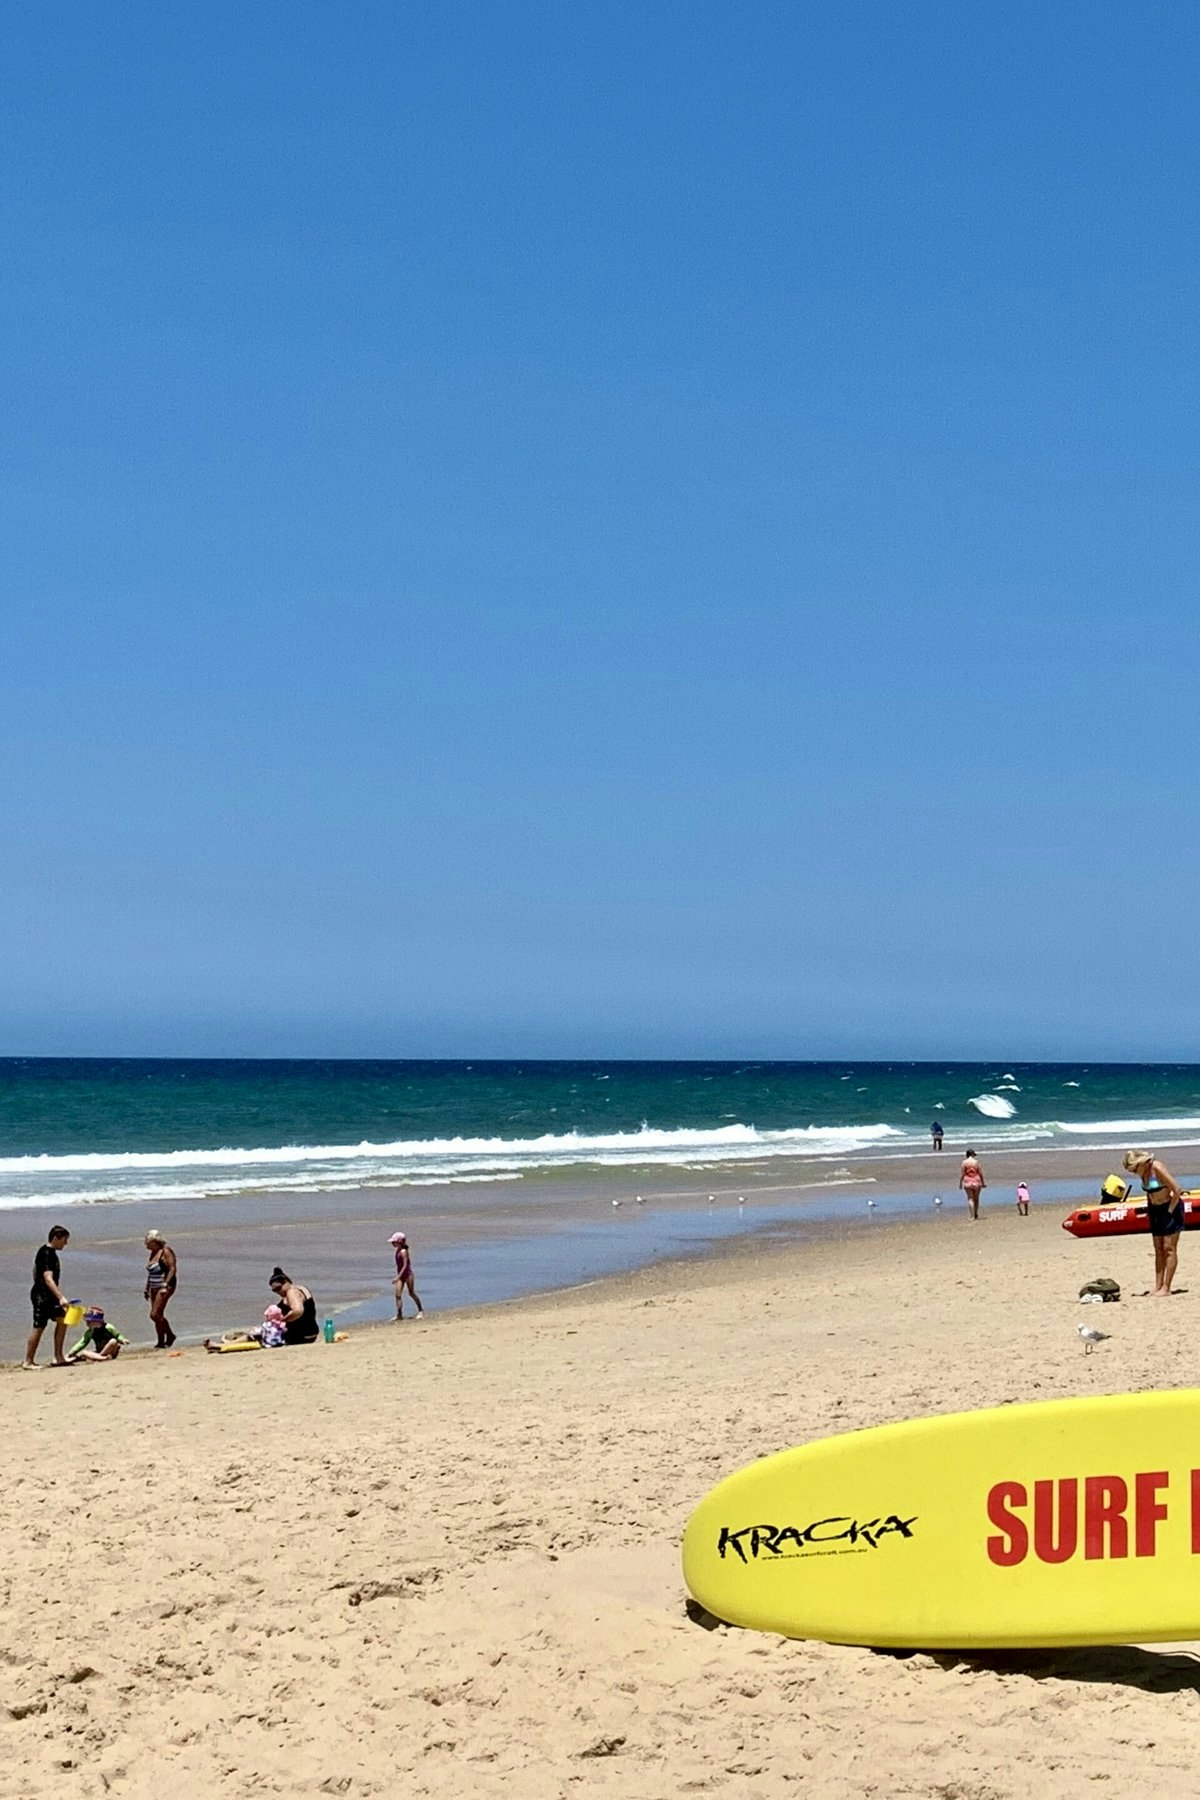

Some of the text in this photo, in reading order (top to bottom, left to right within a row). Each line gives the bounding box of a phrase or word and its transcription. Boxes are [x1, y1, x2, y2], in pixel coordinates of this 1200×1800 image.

[1099, 1209, 1128, 1223] SURF
[718, 1515, 918, 1564] KRACKA
[988, 1471, 1168, 1566] SURF
